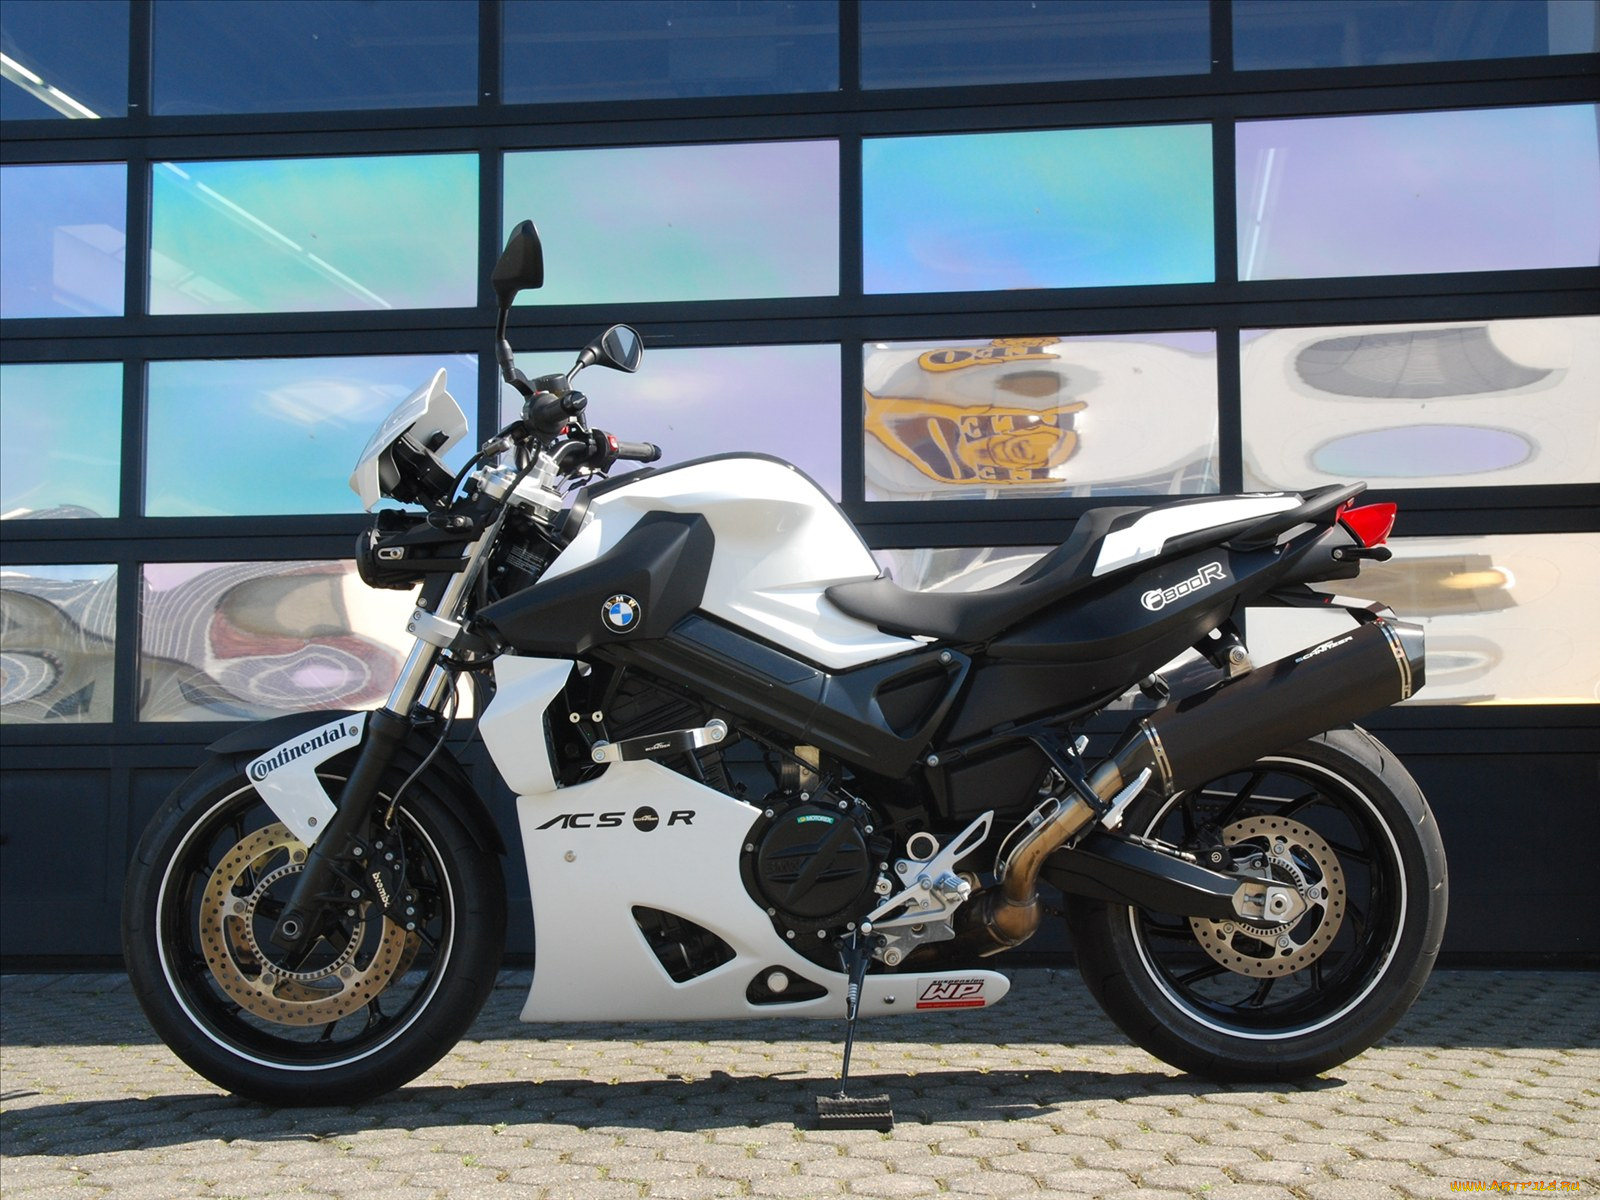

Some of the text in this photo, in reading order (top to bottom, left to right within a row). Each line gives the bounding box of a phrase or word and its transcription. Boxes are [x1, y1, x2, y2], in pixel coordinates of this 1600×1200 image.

[605, 596, 637, 609] BMW
[1141, 562, 1227, 611] F800R
[250, 722, 347, 782] Continental
[919, 983, 984, 1000] WP
